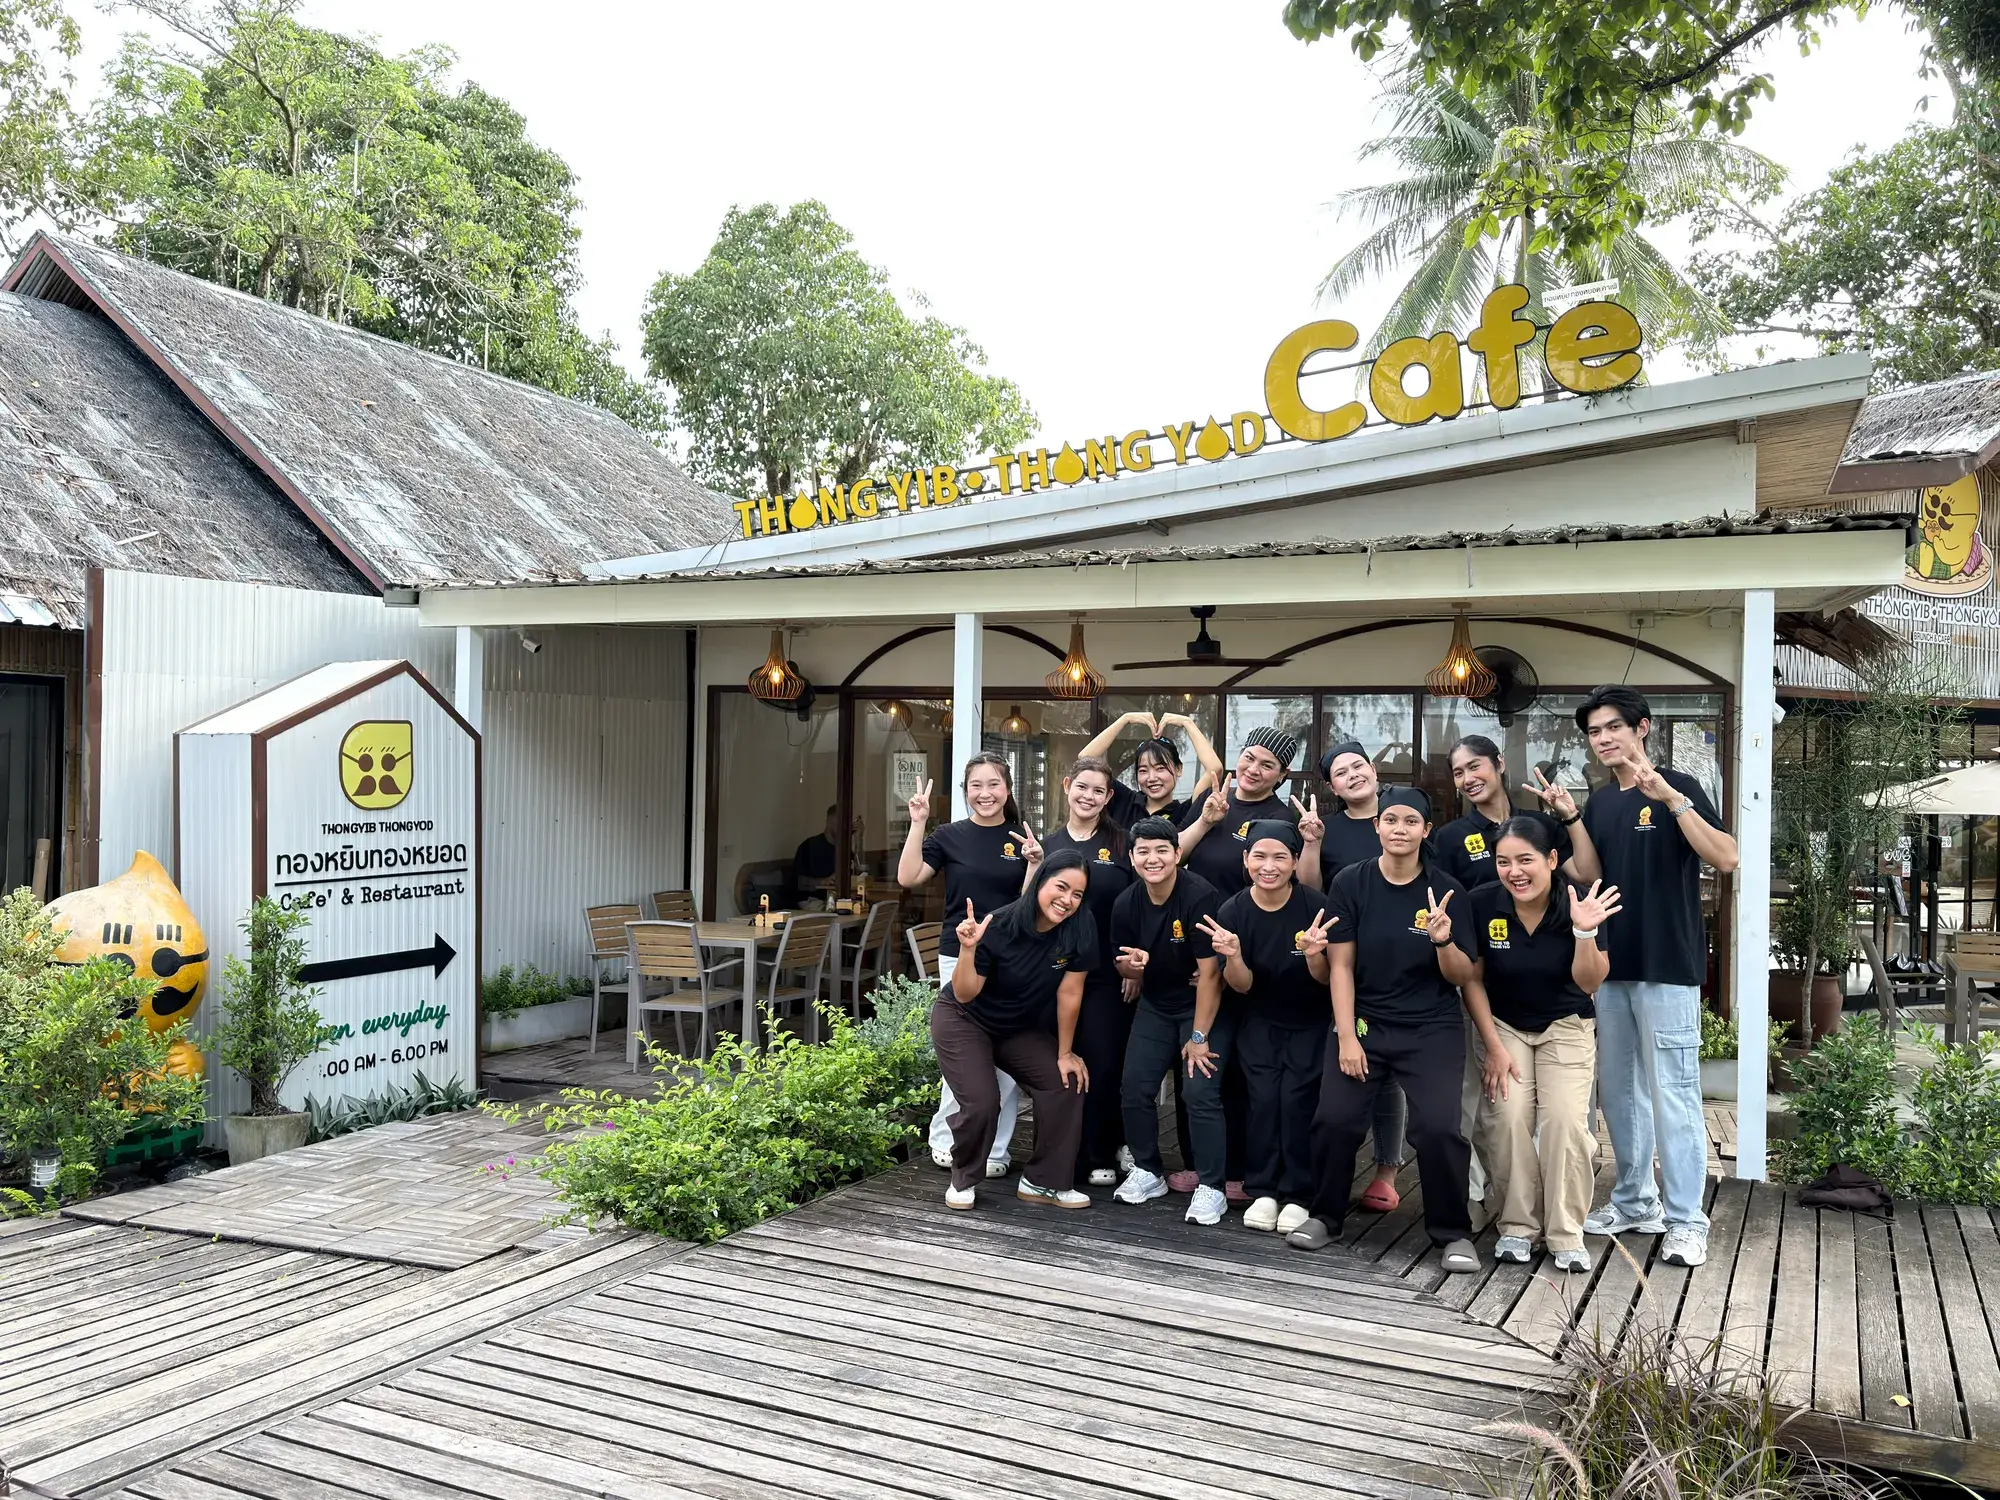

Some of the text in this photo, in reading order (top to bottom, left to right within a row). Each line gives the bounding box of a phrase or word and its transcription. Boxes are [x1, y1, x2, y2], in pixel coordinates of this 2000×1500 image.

[887, 465, 959, 512] YIB
[1264, 283, 1643, 442] Cafe
[1913, 603, 1930, 619] YIB
[1982, 609, 2000, 625] YO
[909, 761, 923, 773] NO
[321, 820, 434, 834] THONGYIB THONGYOD
[276, 844, 467, 875] ทองหยิบทองหยอด
[341, 887, 354, 905] &
[361, 878, 465, 904] Restaurant
[362, 1000, 451, 1038] everyday
[354, 1053, 376, 1072] AM
[391, 1044, 426, 1064] 6.00
[430, 1039, 448, 1056] PM
